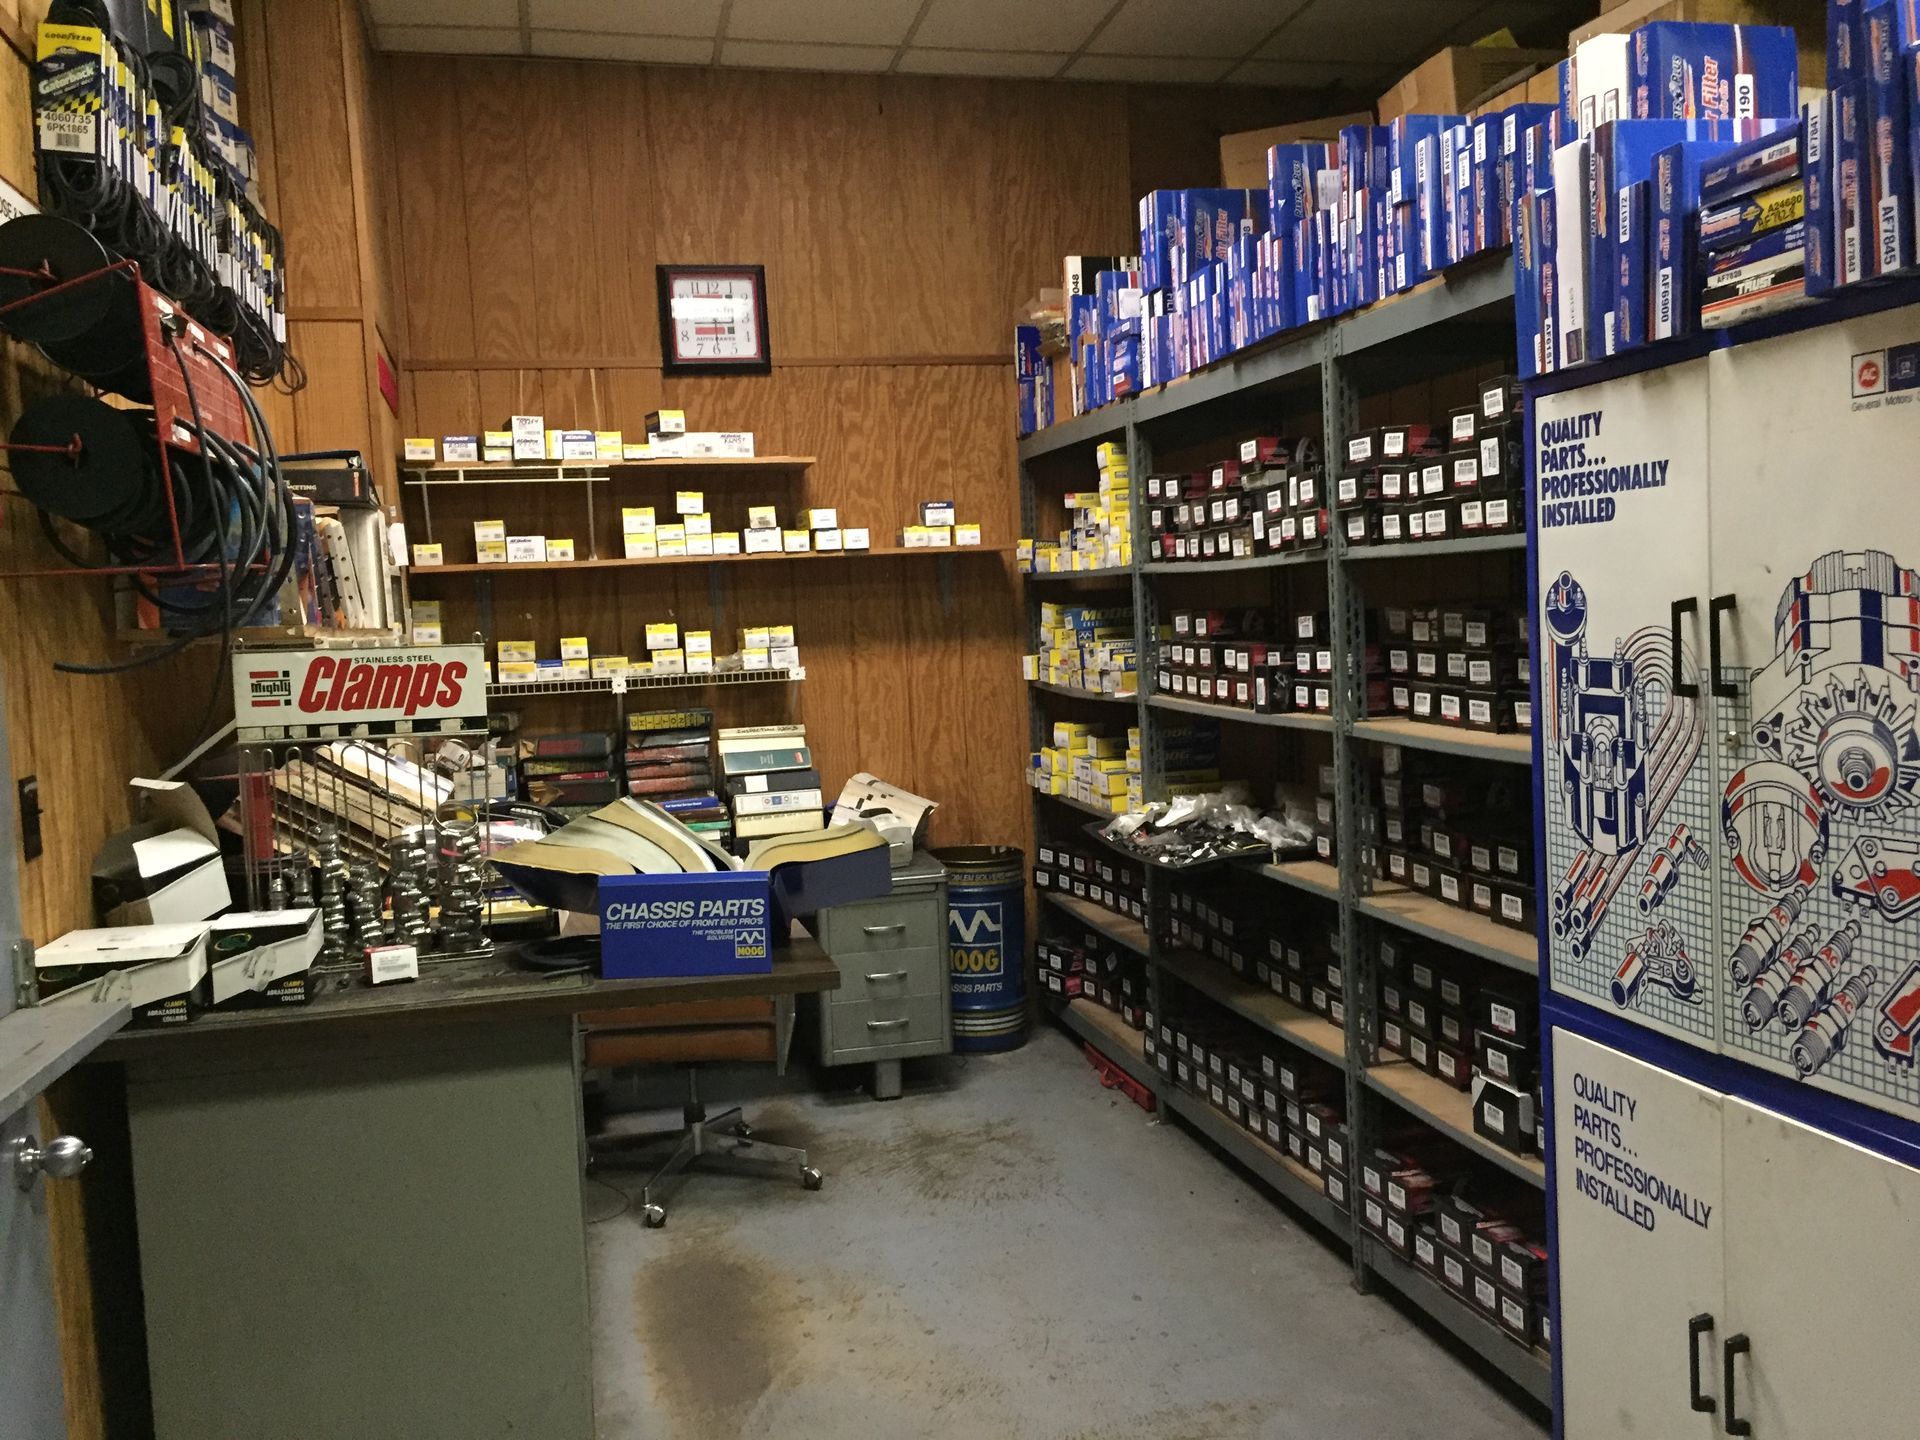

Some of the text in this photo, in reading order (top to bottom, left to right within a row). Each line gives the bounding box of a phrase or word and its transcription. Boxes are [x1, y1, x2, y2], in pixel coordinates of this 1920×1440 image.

[44, 32, 92, 42] GOODYEAR
[1702, 55, 1718, 109] Filter
[44, 112, 92, 125] 4060735
[1673, 98, 1683, 119] RTS
[46, 122, 89, 134] 6PK1865
[1810, 115, 1819, 158] AF7841
[1882, 206, 1897, 265] AF7845
[1847, 238, 1855, 272] AF7843
[706, 280, 720, 294] 12
[1736, 274, 1775, 295] TRUST
[1660, 273, 1670, 323] AF6900
[681, 330, 690, 342] 8
[696, 343, 704, 355] 7
[1860, 367, 1877, 381] AC
[1851, 399, 1881, 412] General
[1541, 410, 1602, 448] QUALITY
[1541, 443, 1606, 474] PARTS...
[1541, 459, 1669, 501] PROFESSIONALLY
[1542, 497, 1616, 528] INSTALLED
[354, 655, 404, 664] STAINLESS
[251, 680, 292, 696] Mighty
[298, 656, 468, 716] Clamps
[606, 898, 765, 921] CHASSIS PARTS
[1770, 906, 1788, 926] AC
[606, 917, 763, 930] THE FIRST CHOICE OF FRONT END PRO'S
[737, 946, 764, 956] MOOG
[950, 948, 999, 972] OOG
[1821, 946, 1838, 969] AC
[974, 982, 1003, 993] PARTS
[147, 1008, 187, 1016] ABRAZADERAS
[1833, 991, 1854, 1014] AC
[1573, 1072, 1636, 1122] QUALITY
[1574, 1103, 1638, 1157] PARTS...
[1575, 1135, 1712, 1230] PROFESSIONALLY
[1576, 1167, 1655, 1232] INSTALLED
